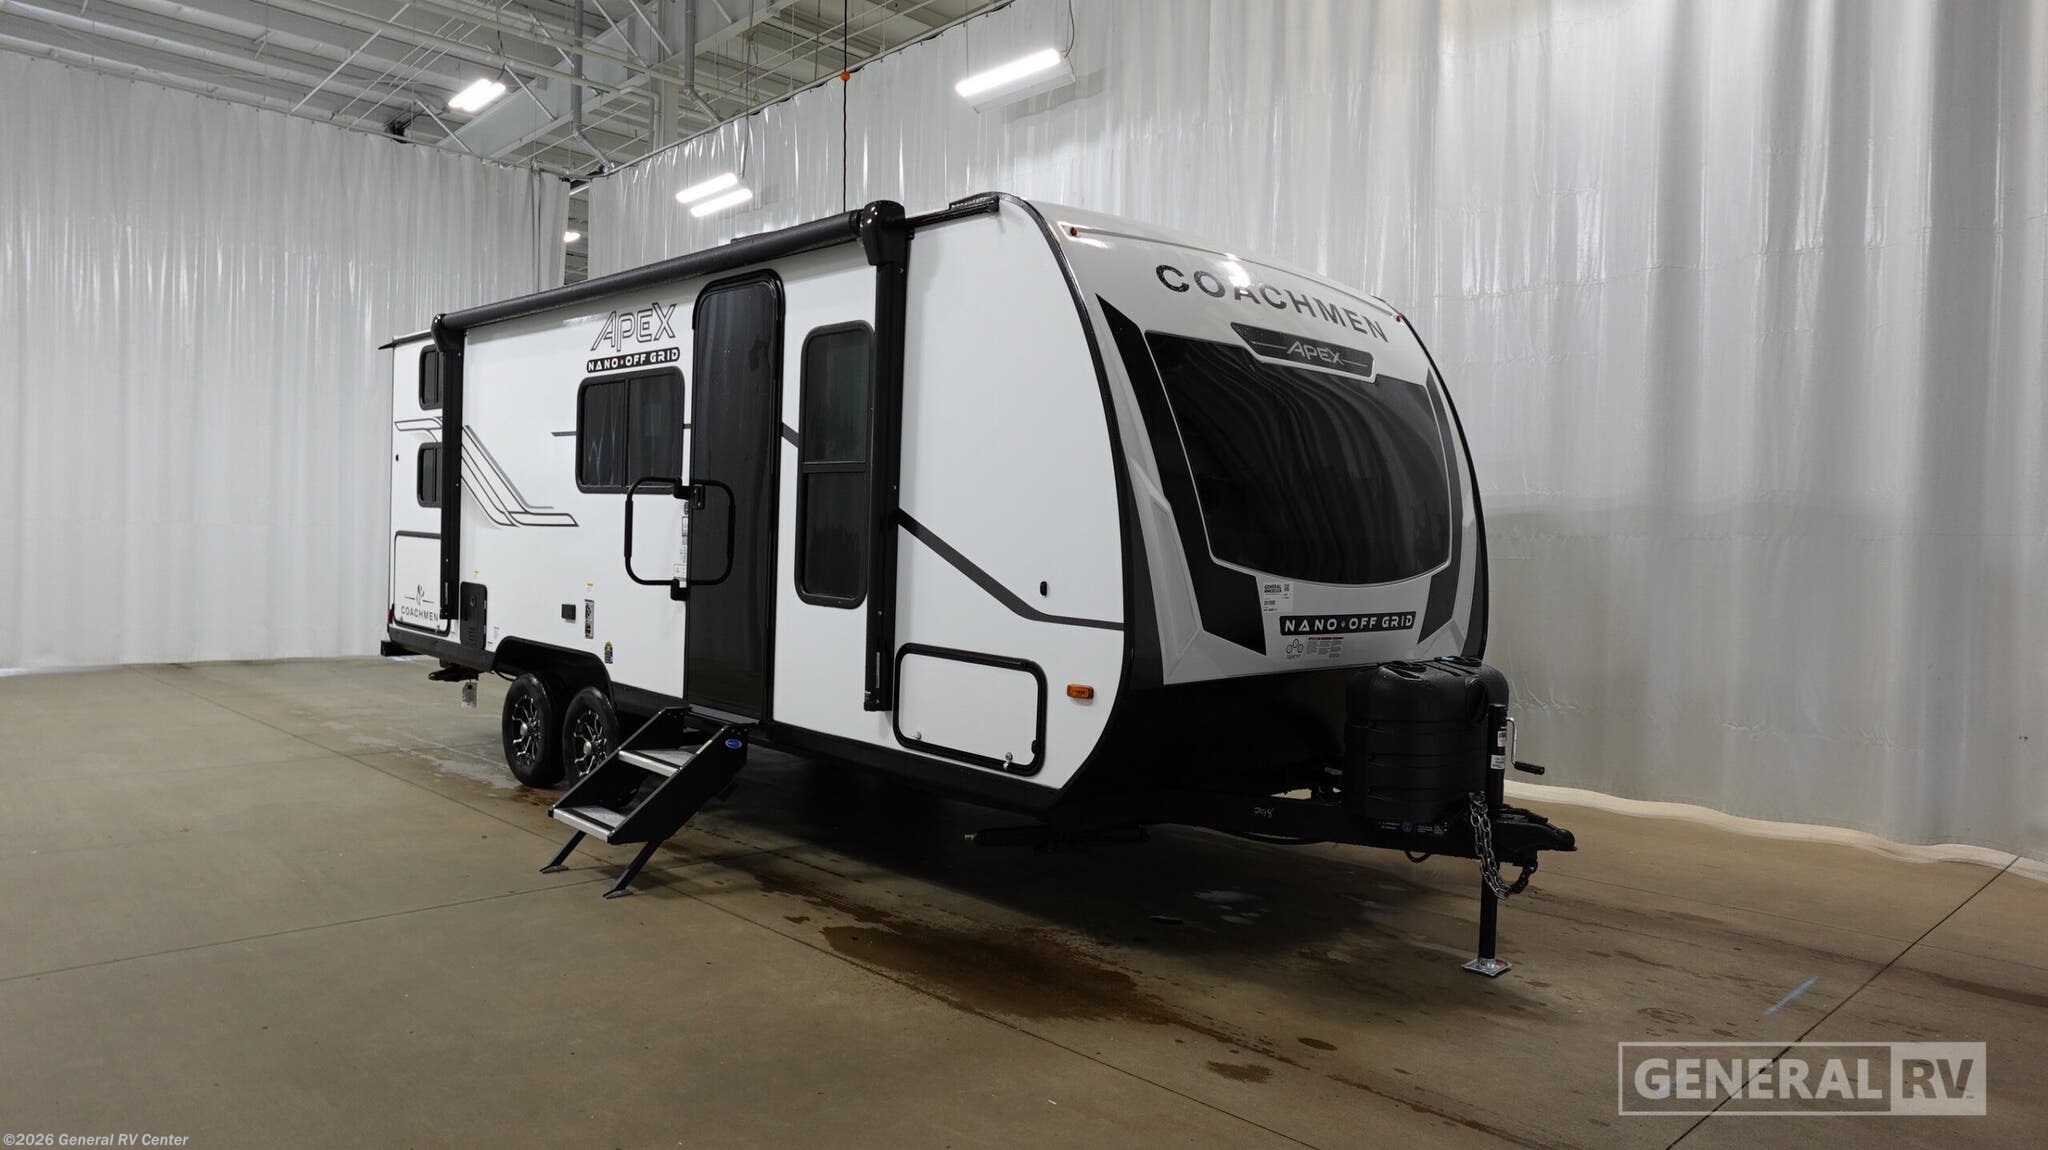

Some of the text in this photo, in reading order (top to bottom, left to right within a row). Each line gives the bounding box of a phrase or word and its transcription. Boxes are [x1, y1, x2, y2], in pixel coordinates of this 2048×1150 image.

[1156, 264, 1389, 343] COACHMEN
[590, 302, 677, 352] APEX
[588, 349, 679, 371] NANO OFF GRID
[1287, 341, 1344, 365] APEX
[401, 606, 439, 621] COACHMEN
[1284, 615, 1413, 632] NANO OFF GRID
